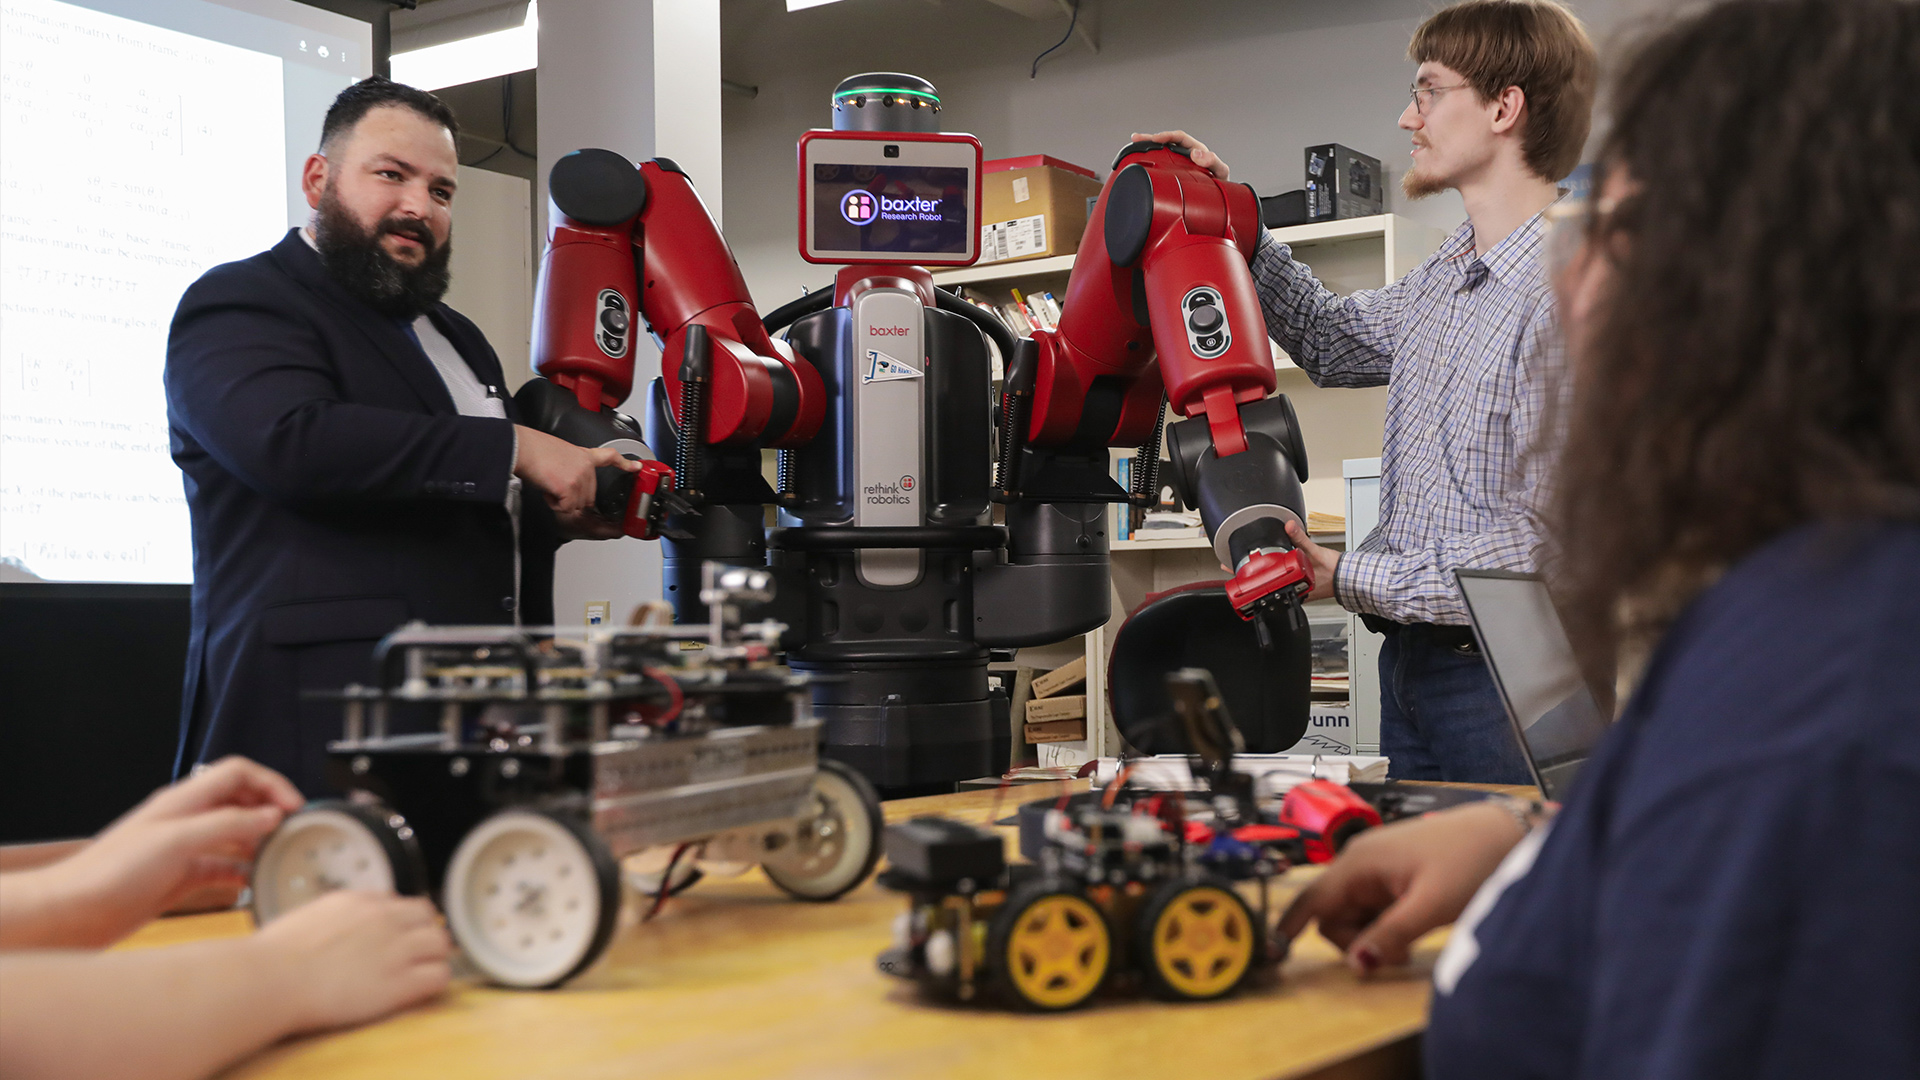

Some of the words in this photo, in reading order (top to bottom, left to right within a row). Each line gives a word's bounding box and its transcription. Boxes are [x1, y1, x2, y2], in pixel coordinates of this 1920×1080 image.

[0, 7, 69, 30] sformation
[74, 24, 111, 40] matrix
[117, 33, 144, 48] from
[148, 41, 179, 57] frame
[6, 23, 60, 45] followed
[881, 195, 940, 212] baxter
[881, 212, 918, 221] Research
[919, 212, 943, 222] Robot
[0, 215, 31, 226] rame
[99, 228, 115, 240] the
[126, 232, 151, 245] base
[0, 232, 48, 246] rmation
[52, 239, 90, 252] matrix
[95, 246, 113, 256] can
[118, 248, 130, 259] be
[134, 252, 187, 268] computed
[60, 308, 76, 319] the
[111, 316, 146, 328] angles
[870, 325, 910, 336] baxter
[890, 364, 897, 374] GO
[101, 420, 132, 431] frame
[2, 433, 49, 445] position
[55, 437, 90, 448] vector
[110, 440, 126, 451] the
[131, 443, 150, 453] end
[48, 487, 64, 498] the
[70, 490, 112, 501] particle
[125, 494, 144, 503] can
[149, 493, 160, 503] be
[864, 482, 900, 494] rethink
[867, 494, 911, 504] robotics
